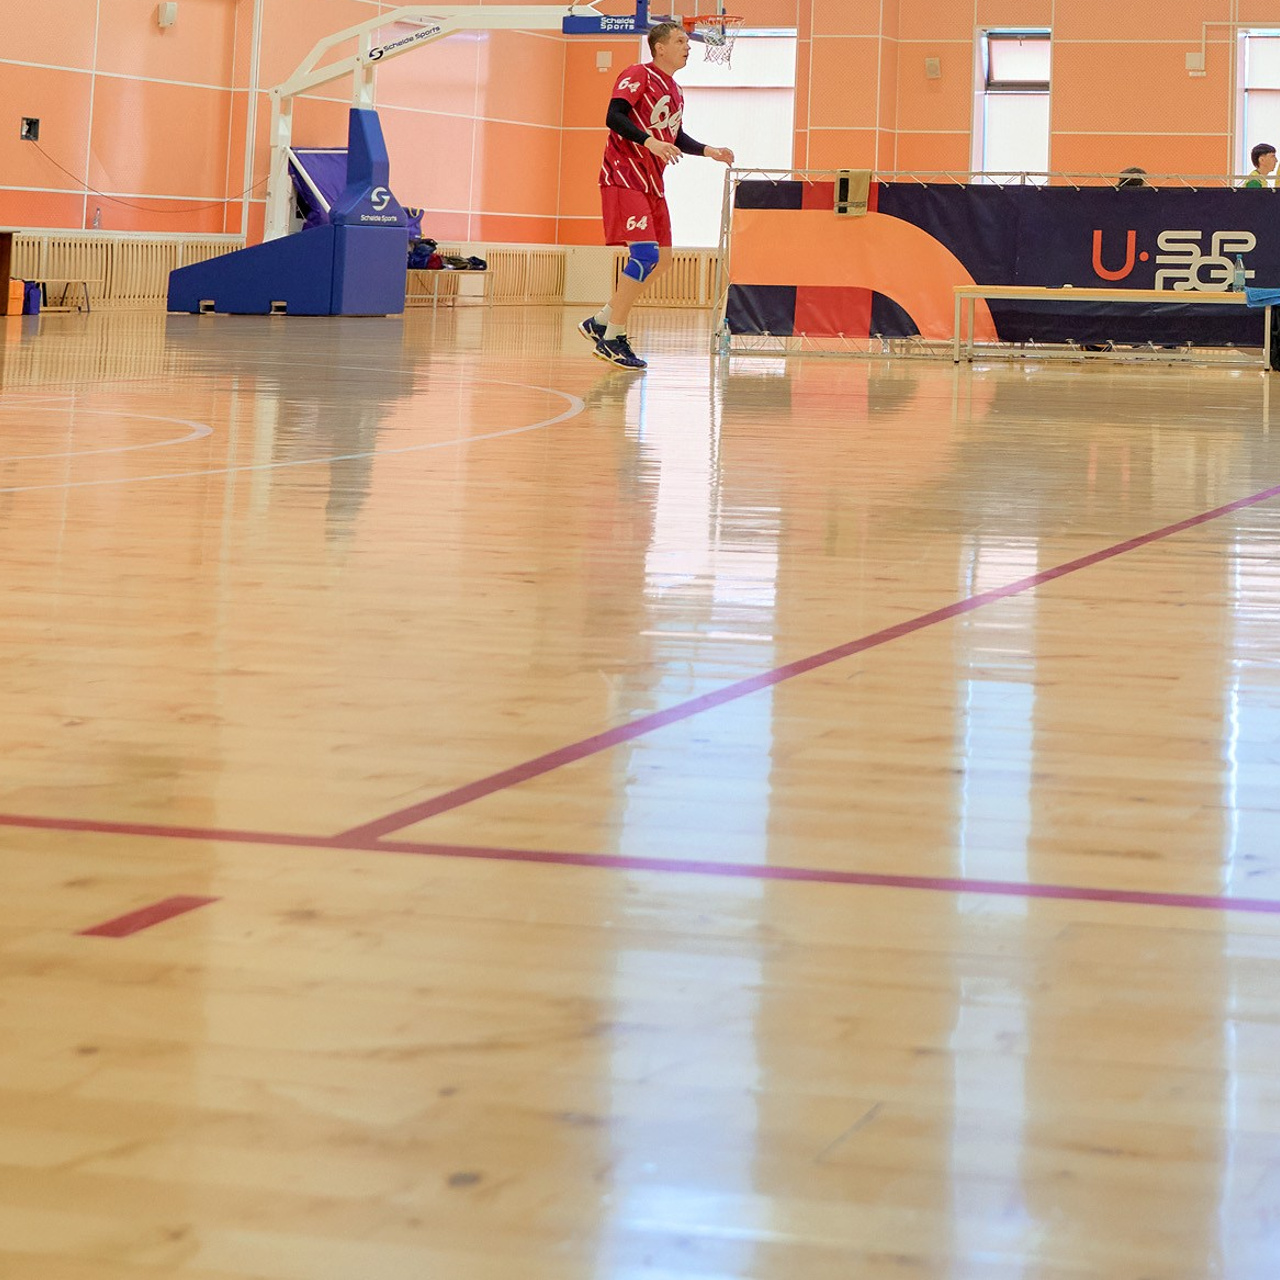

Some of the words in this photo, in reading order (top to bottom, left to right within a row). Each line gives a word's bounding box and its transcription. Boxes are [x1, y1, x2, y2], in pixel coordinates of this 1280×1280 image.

[414, 25, 441, 39] Sports
[600, 23, 635, 31] Sports
[626, 215, 648, 231] 64
